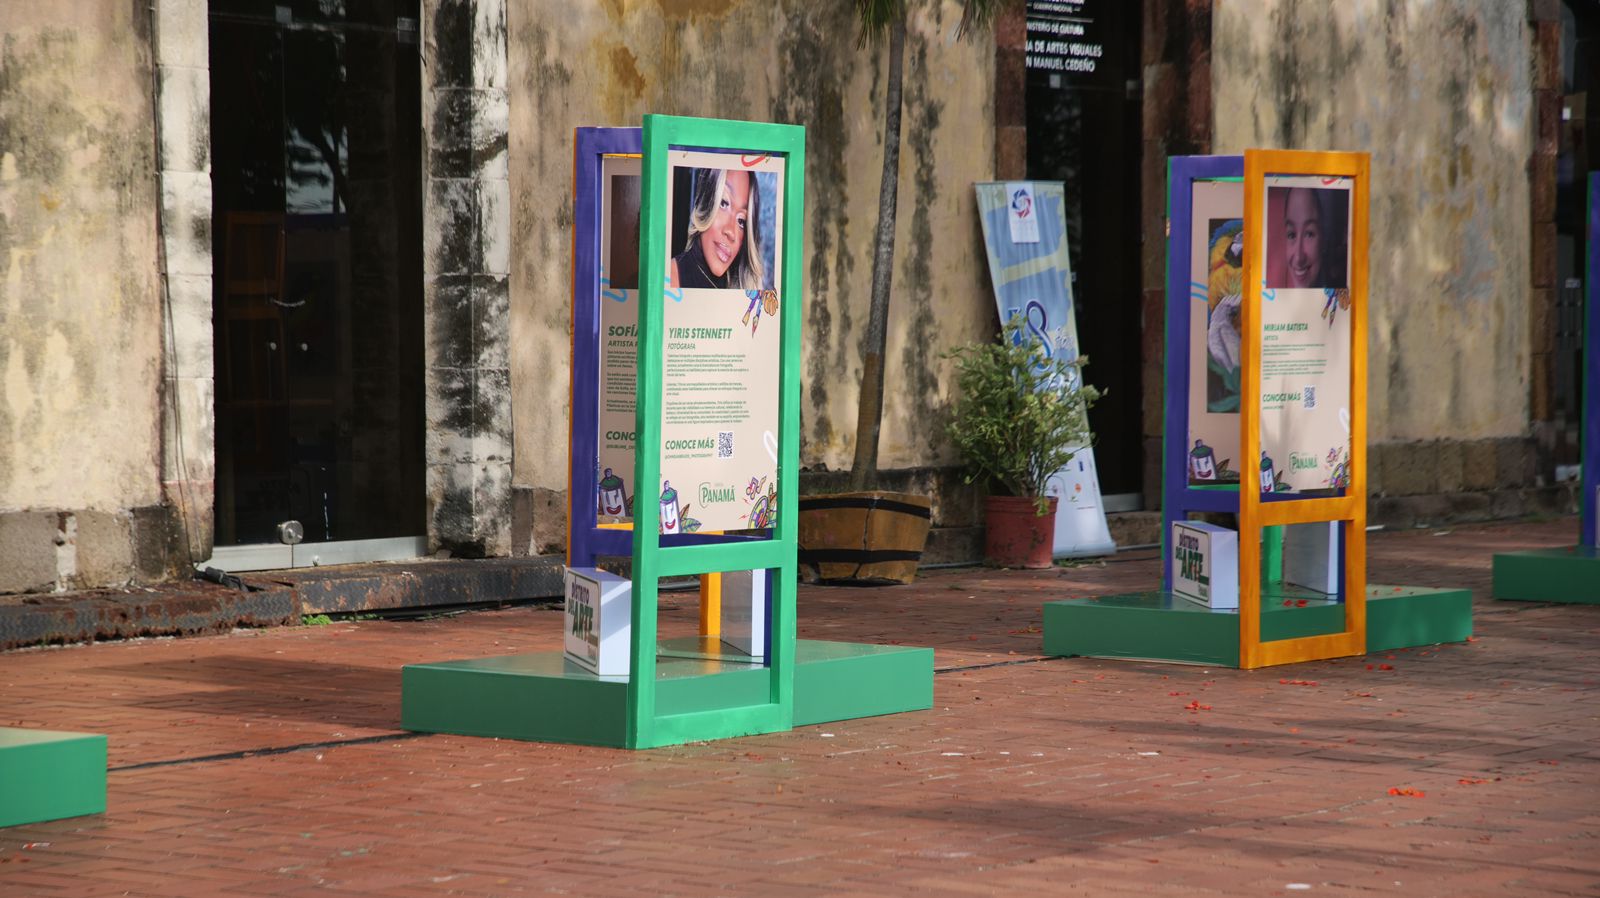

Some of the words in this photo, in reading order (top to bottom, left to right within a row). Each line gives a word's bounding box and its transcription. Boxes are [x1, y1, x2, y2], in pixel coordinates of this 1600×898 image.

[1026, 21, 1050, 32] NISTERIO
[1051, 23, 1059, 33] DE
[1059, 24, 1085, 35] CULTURA
[1034, 40, 1045, 53] DE
[1046, 41, 1068, 55] ARTES
[1069, 43, 1103, 57] VISUALES
[1034, 56, 1065, 70] MANUEL
[1065, 58, 1096, 72] CEDEÑO
[691, 327, 733, 339] STENNETT
[1264, 324, 1286, 332] MIRIAM
[1286, 323, 1308, 332] BATISTA
[1262, 393, 1287, 402] CONOCE
[1287, 391, 1301, 401] MÁS
[605, 430, 637, 441] CONO
[665, 440, 697, 450] CONOCE
[697, 437, 715, 449] MÁS
[702, 485, 736, 503] PANAMÁ
[1181, 548, 1203, 582] ARTE
[572, 601, 594, 642] ARTE
